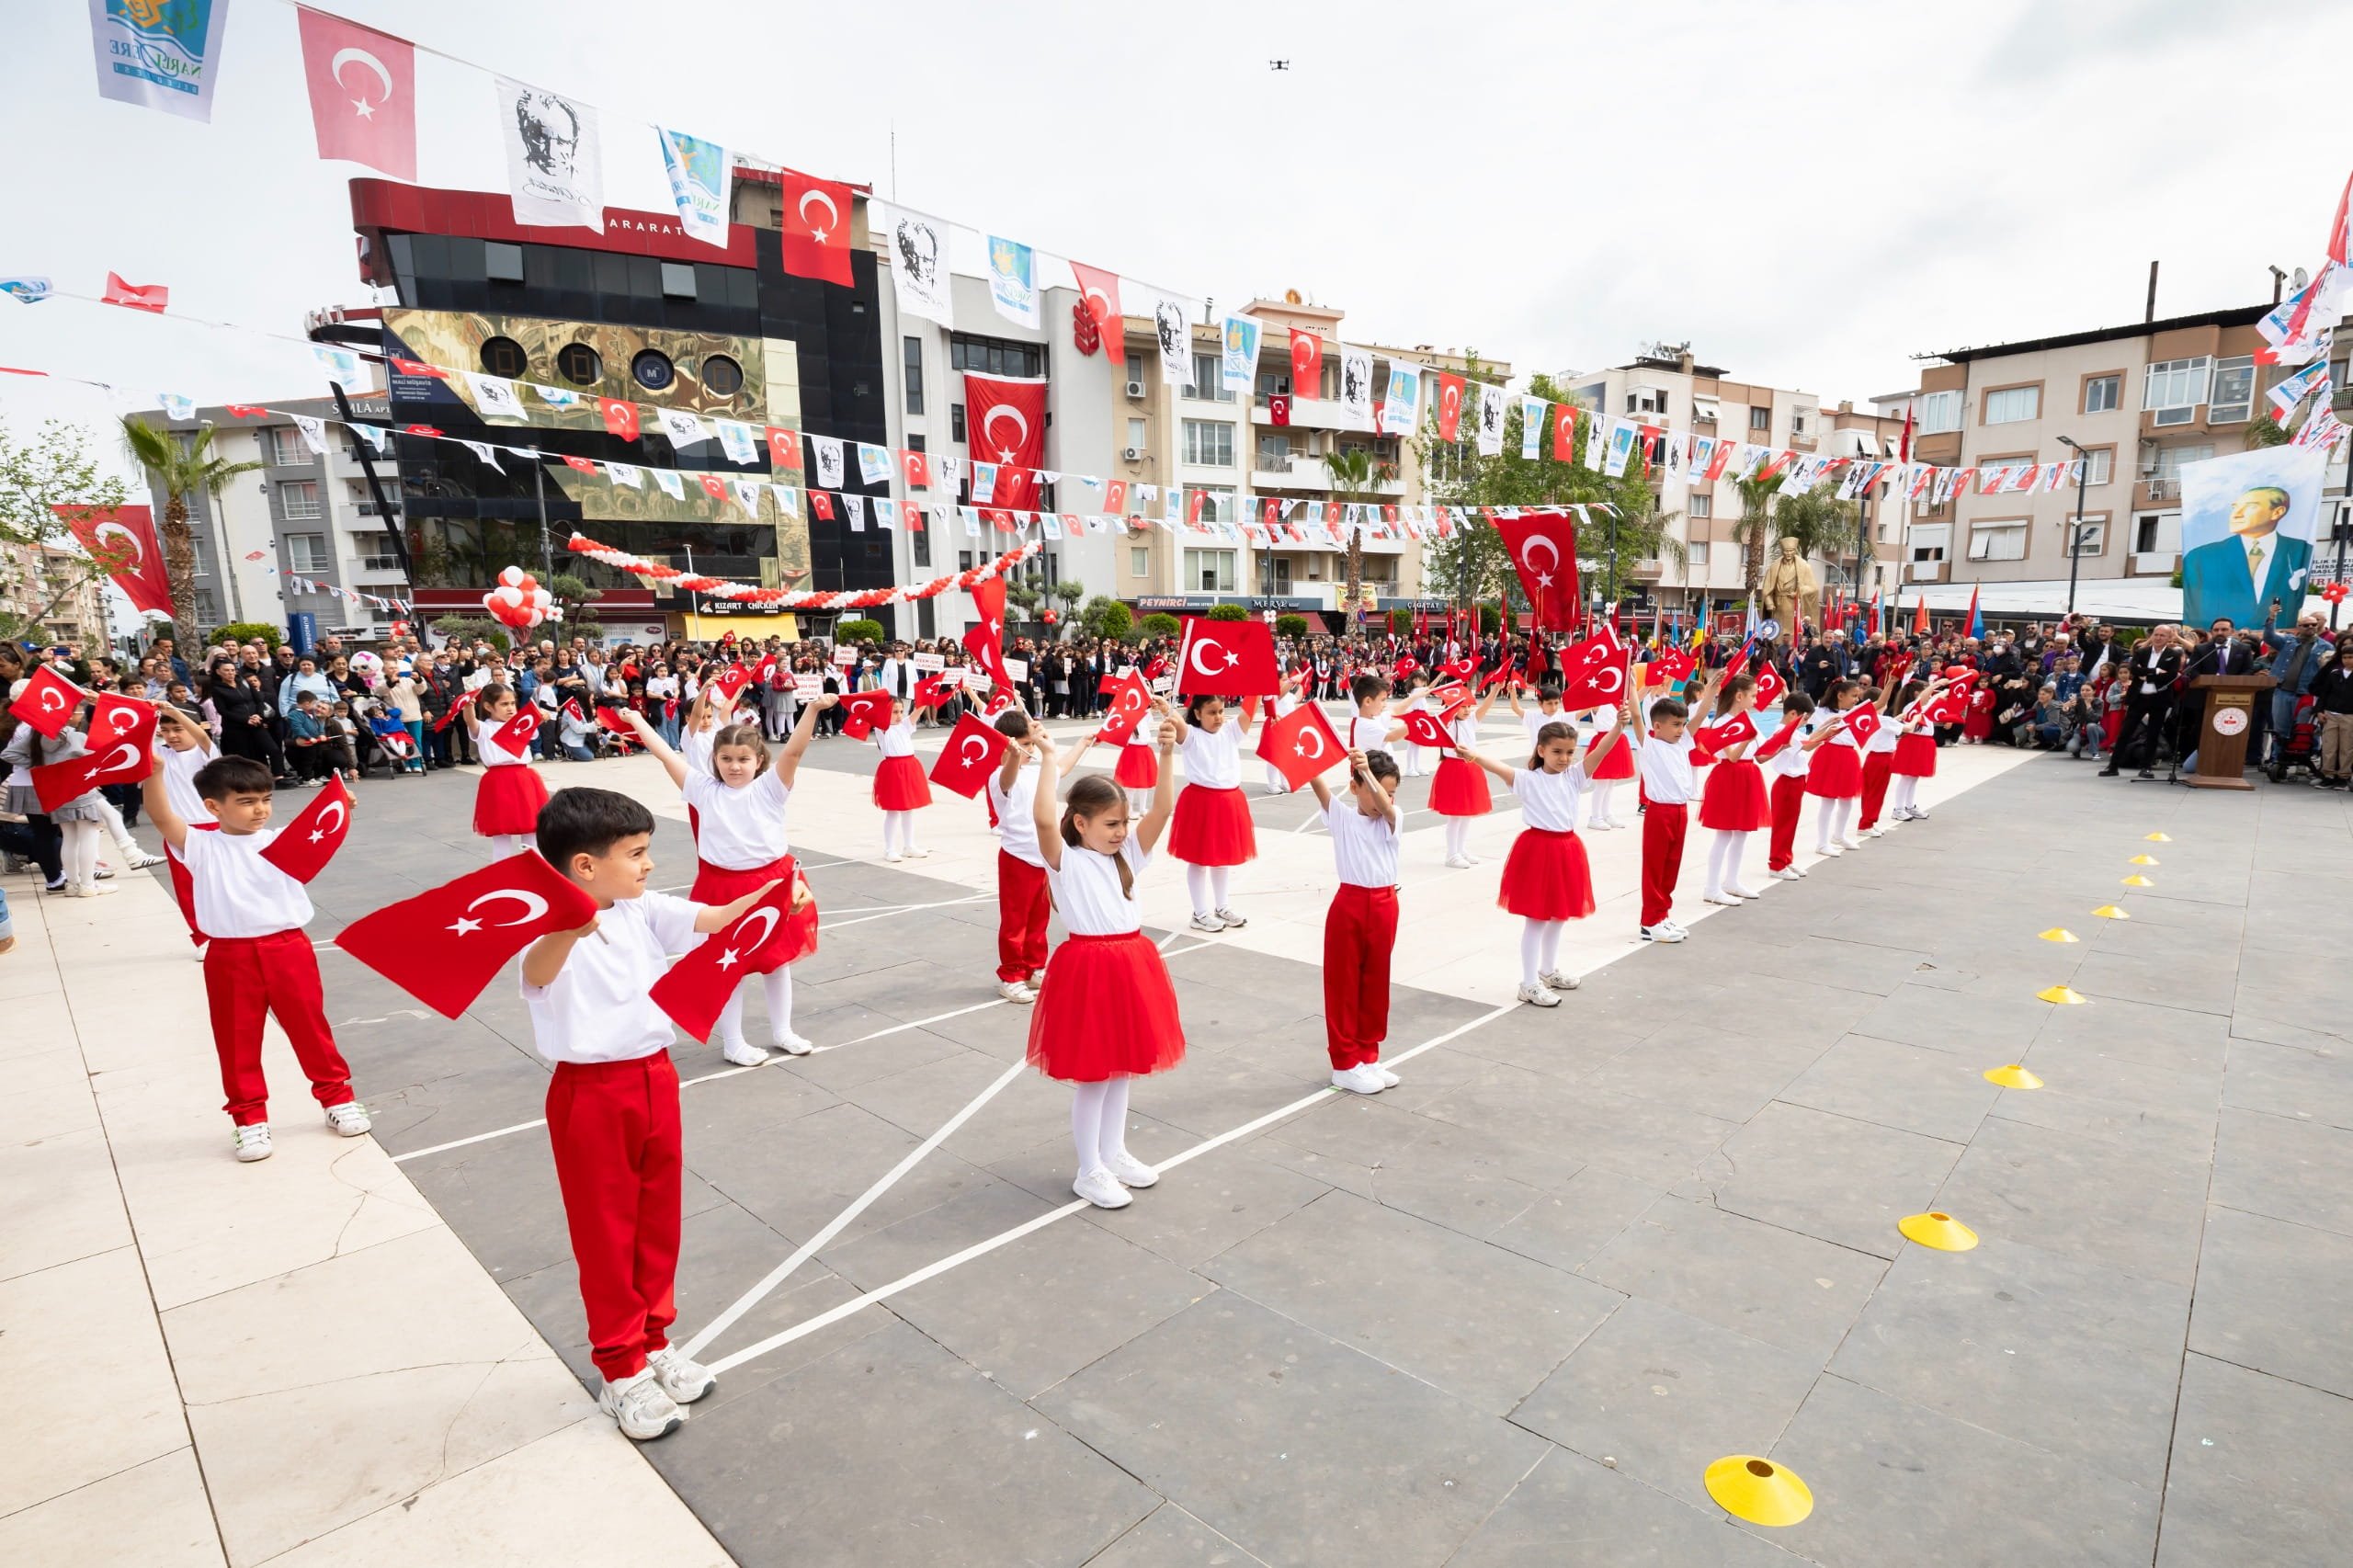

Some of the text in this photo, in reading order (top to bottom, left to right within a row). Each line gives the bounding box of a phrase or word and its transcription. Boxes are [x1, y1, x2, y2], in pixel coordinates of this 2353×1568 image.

[609, 218, 683, 236] ARARAT
[332, 400, 372, 415] SMLÂ
[1140, 597, 1187, 608] PEYNİRCİ
[1254, 599, 1288, 609] MERVE
